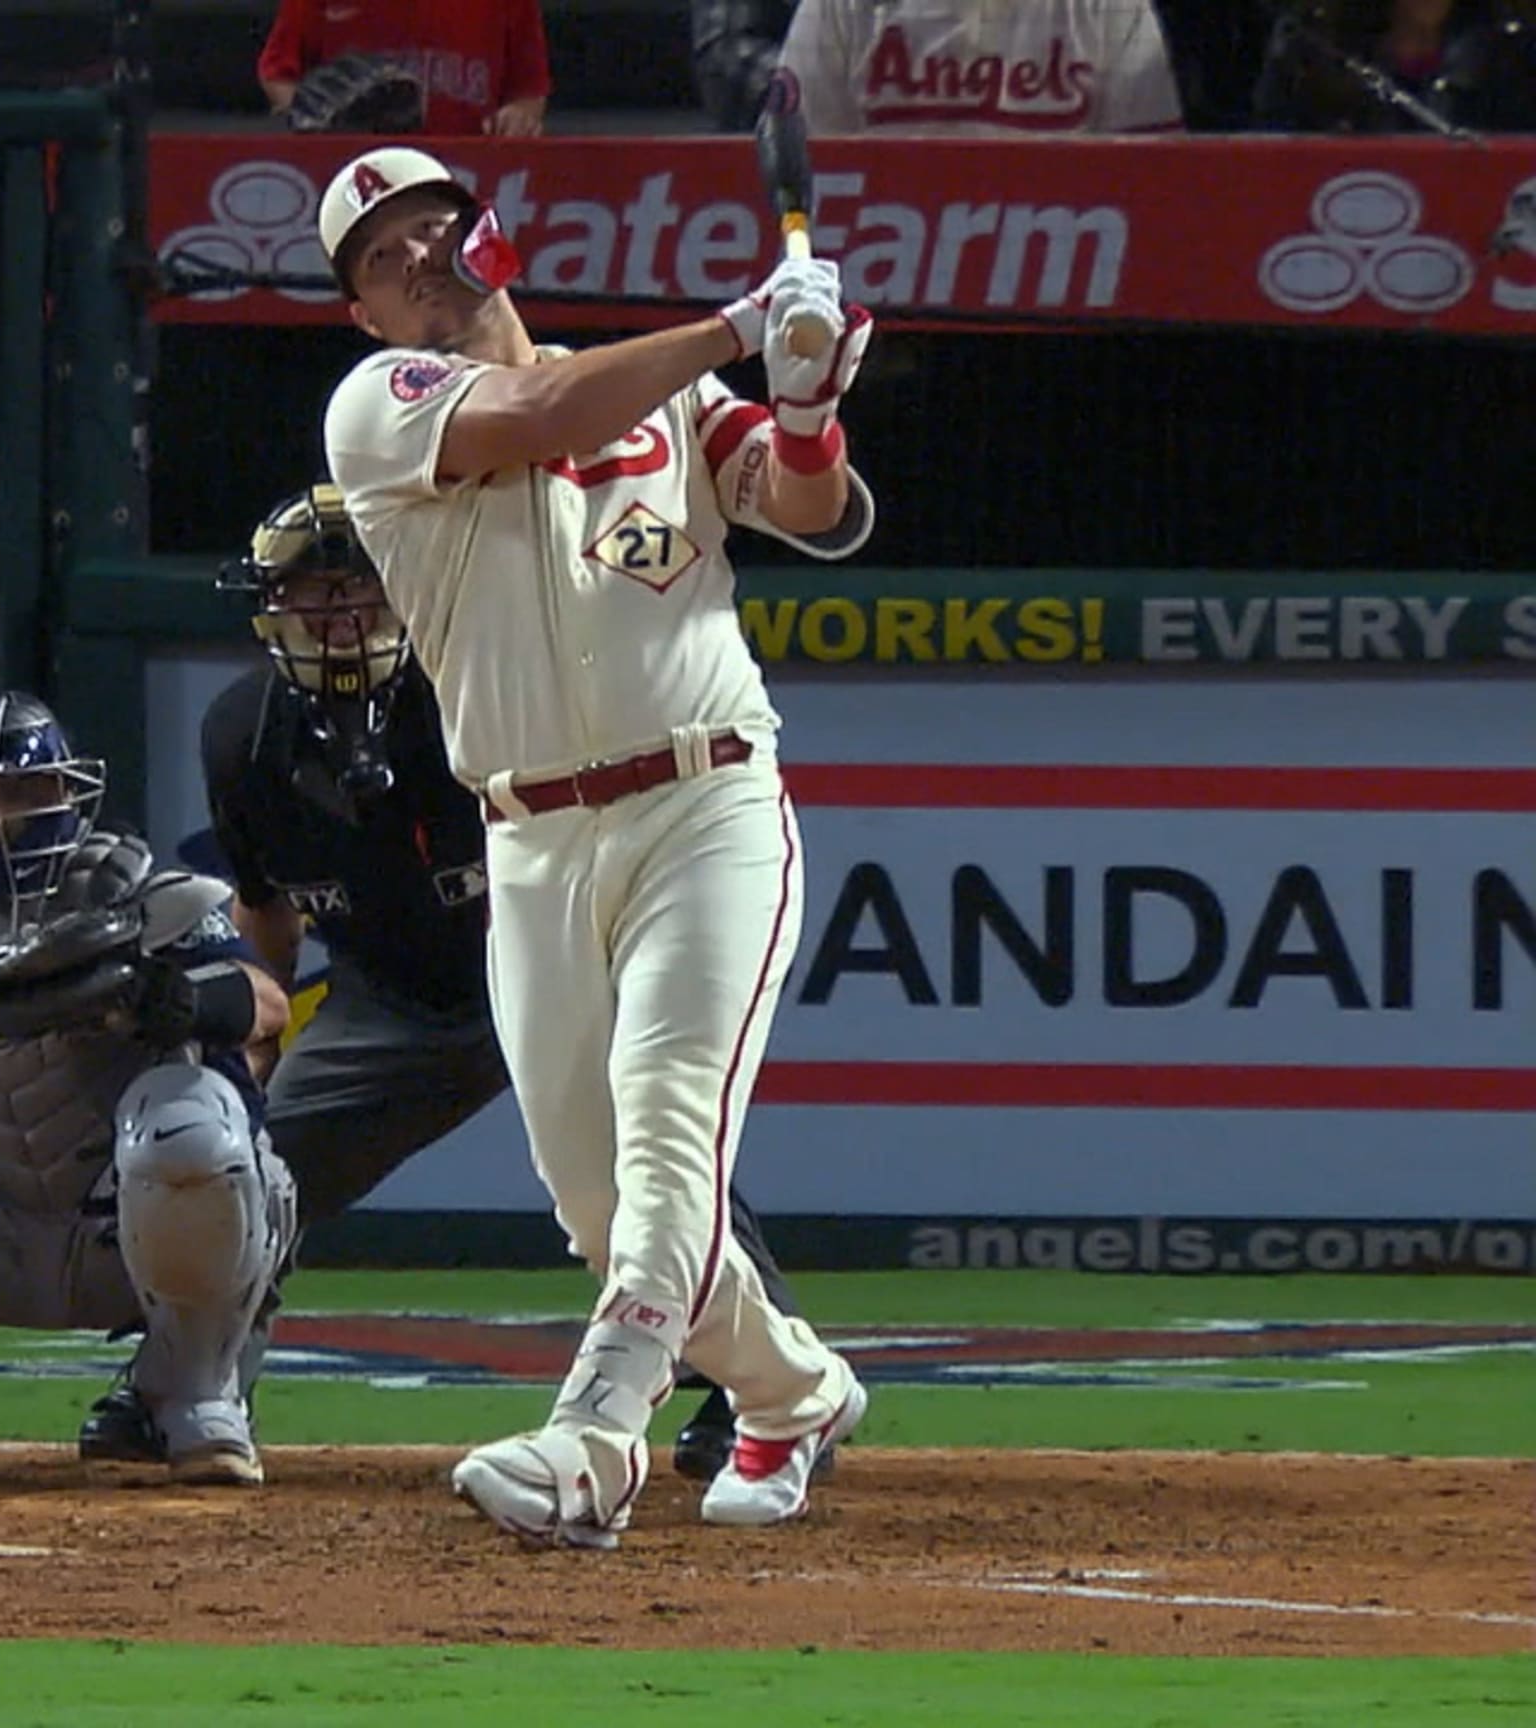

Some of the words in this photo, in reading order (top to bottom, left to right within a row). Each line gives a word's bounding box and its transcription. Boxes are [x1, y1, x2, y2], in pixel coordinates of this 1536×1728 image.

[867, 25, 1094, 128] Angels
[452, 168, 759, 299] tate
[615, 526, 672, 568] 27
[741, 596, 1104, 662] WORKS!
[1141, 598, 1470, 662] EVERY
[797, 860, 1415, 1011] ANDAI
